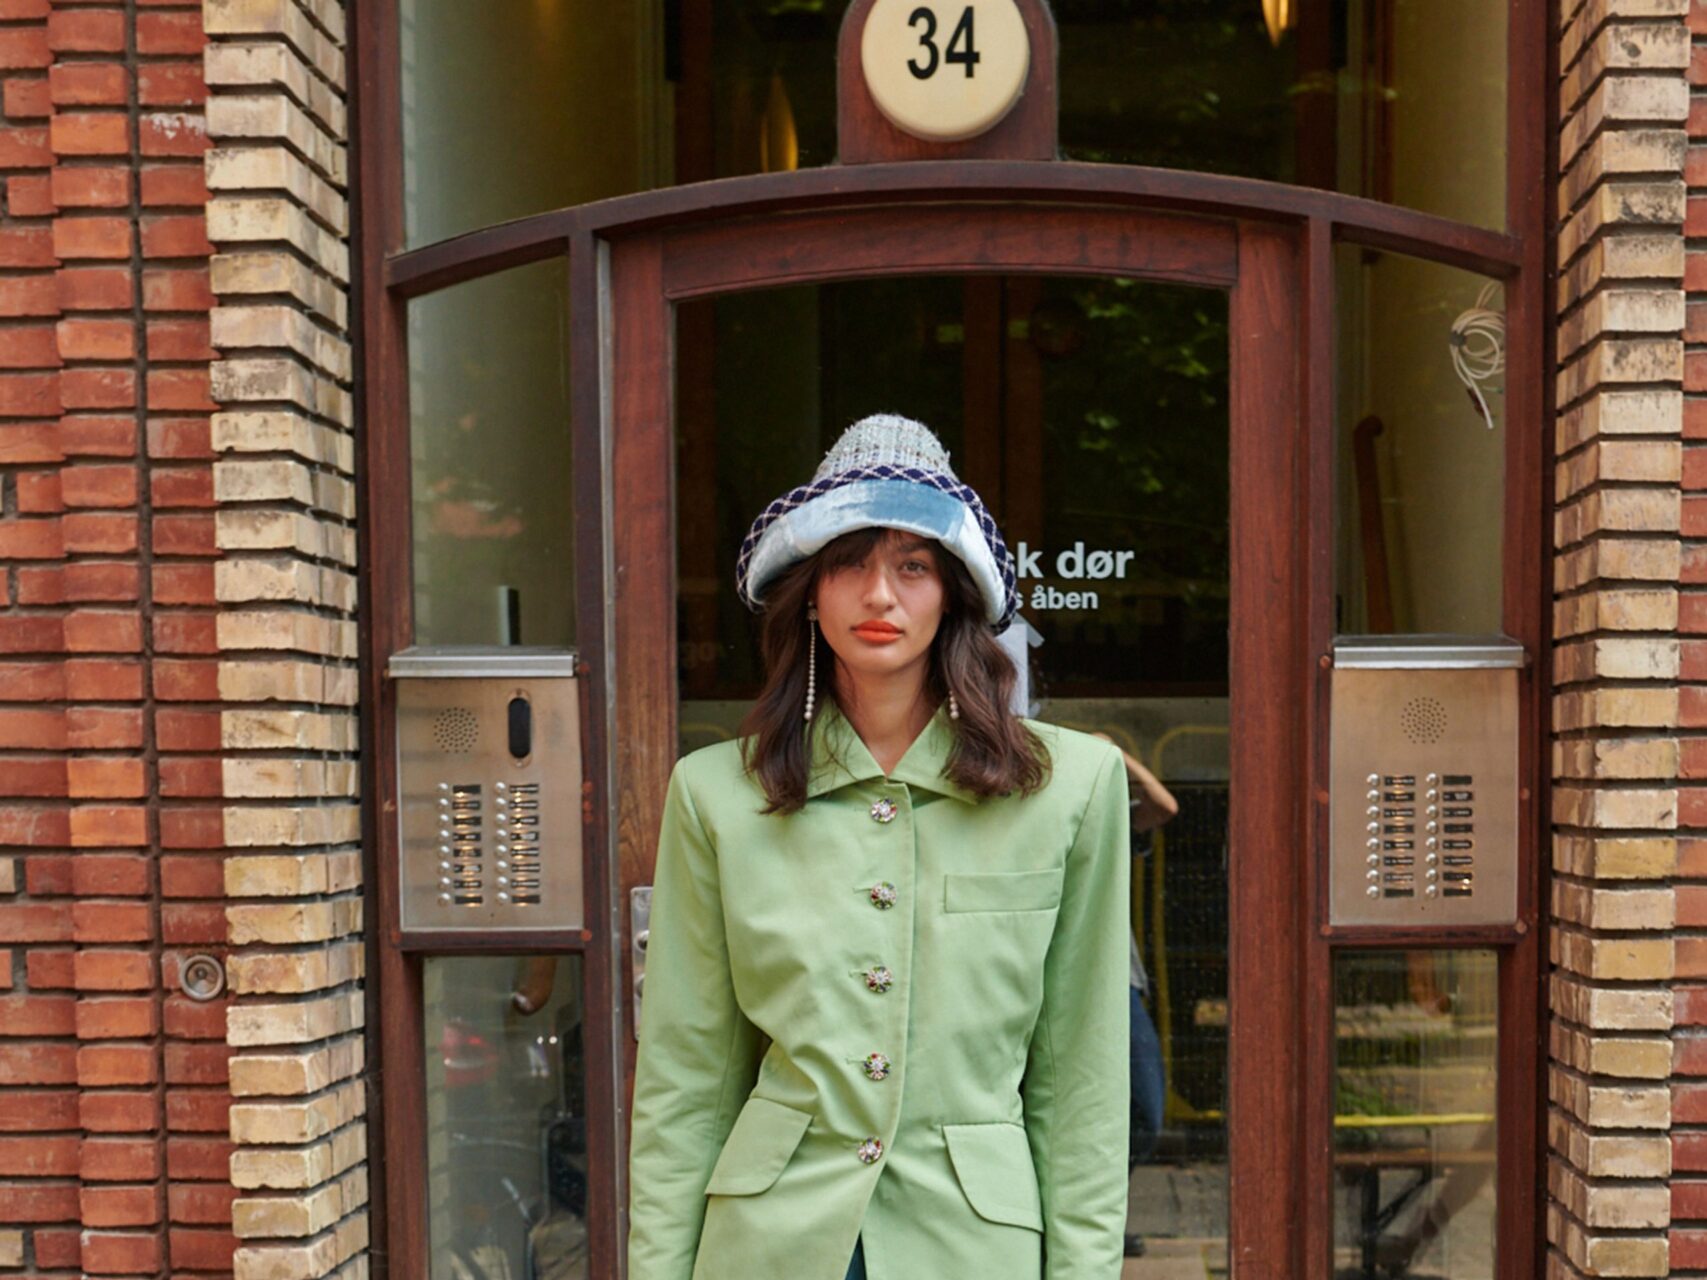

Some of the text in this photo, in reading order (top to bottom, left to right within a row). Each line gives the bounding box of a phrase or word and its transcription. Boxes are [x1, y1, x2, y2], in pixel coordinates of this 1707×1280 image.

[907, 6, 980, 80] 34
[1056, 541, 1135, 579] dør
[1030, 584, 1099, 610] åben
